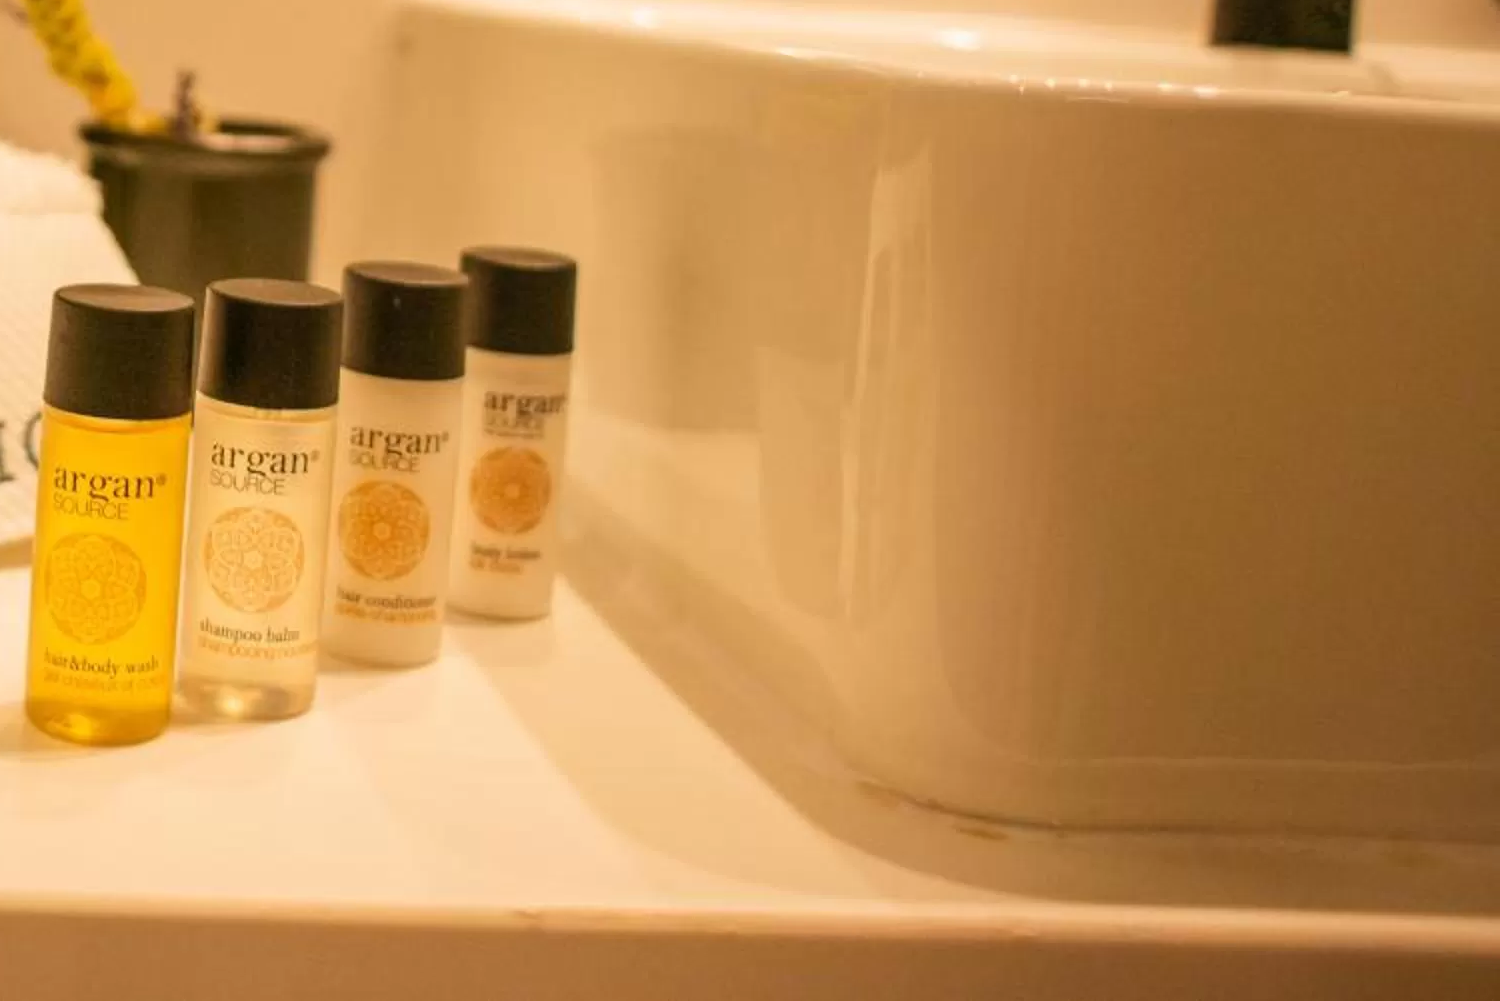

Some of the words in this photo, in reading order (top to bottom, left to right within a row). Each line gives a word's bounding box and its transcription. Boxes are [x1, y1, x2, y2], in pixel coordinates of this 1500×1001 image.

[210, 469, 285, 495] SOURCE
[53, 494, 129, 520] SOURCE
[200, 617, 262, 643] shampoo
[44, 647, 119, 679] hair&body
[125, 654, 159, 673] wash
